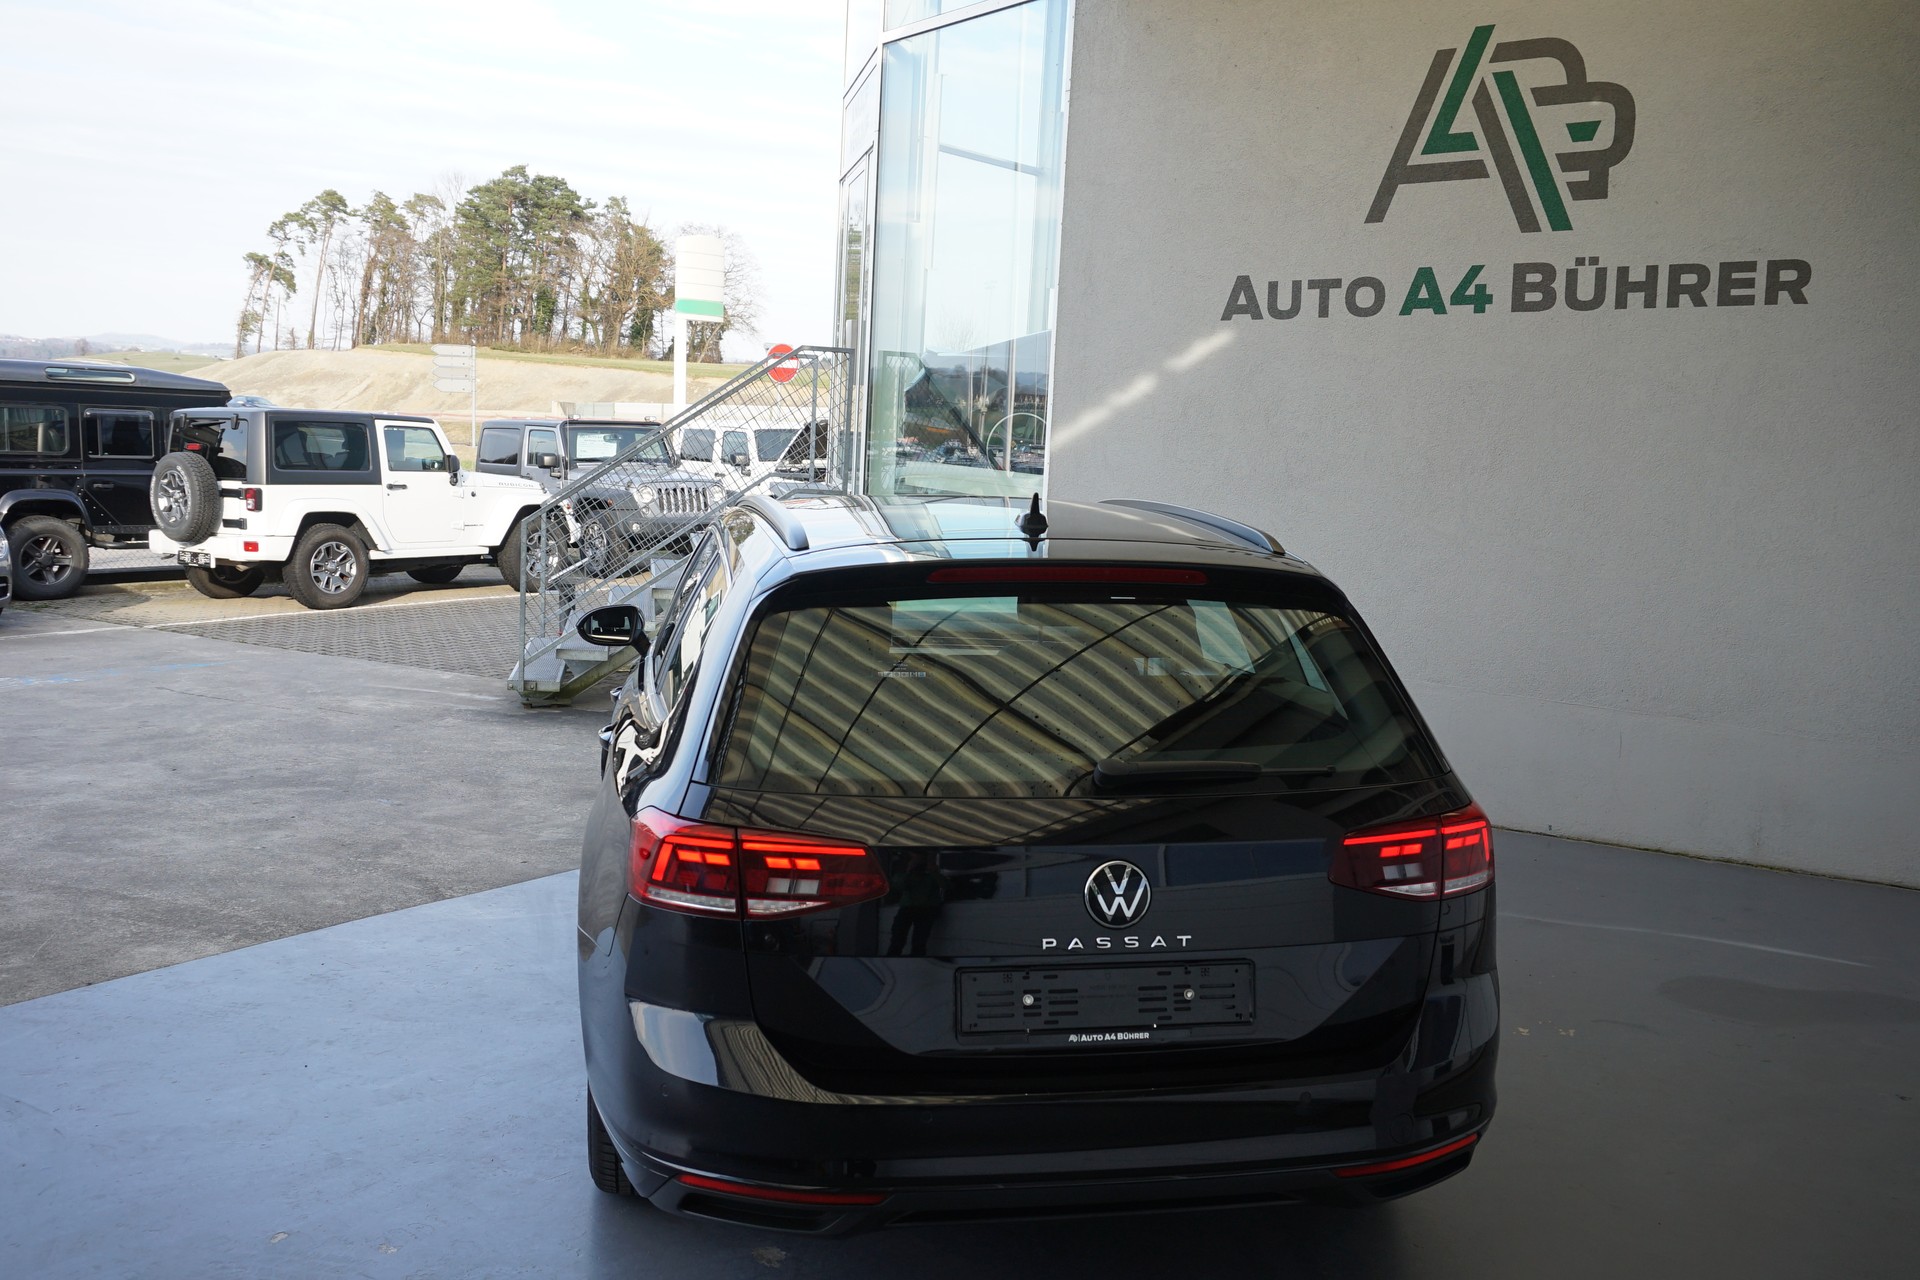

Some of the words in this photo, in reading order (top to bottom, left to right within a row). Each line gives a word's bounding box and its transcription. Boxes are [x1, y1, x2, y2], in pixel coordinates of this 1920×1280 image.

[1220, 274, 1386, 321] AUTO
[1398, 264, 1494, 316] A4
[1510, 256, 1813, 313] BÜHRER
[1042, 935, 1192, 950] PASSAT
[1080, 1034, 1103, 1042] AUTO
[1104, 1033, 1116, 1041] A4
